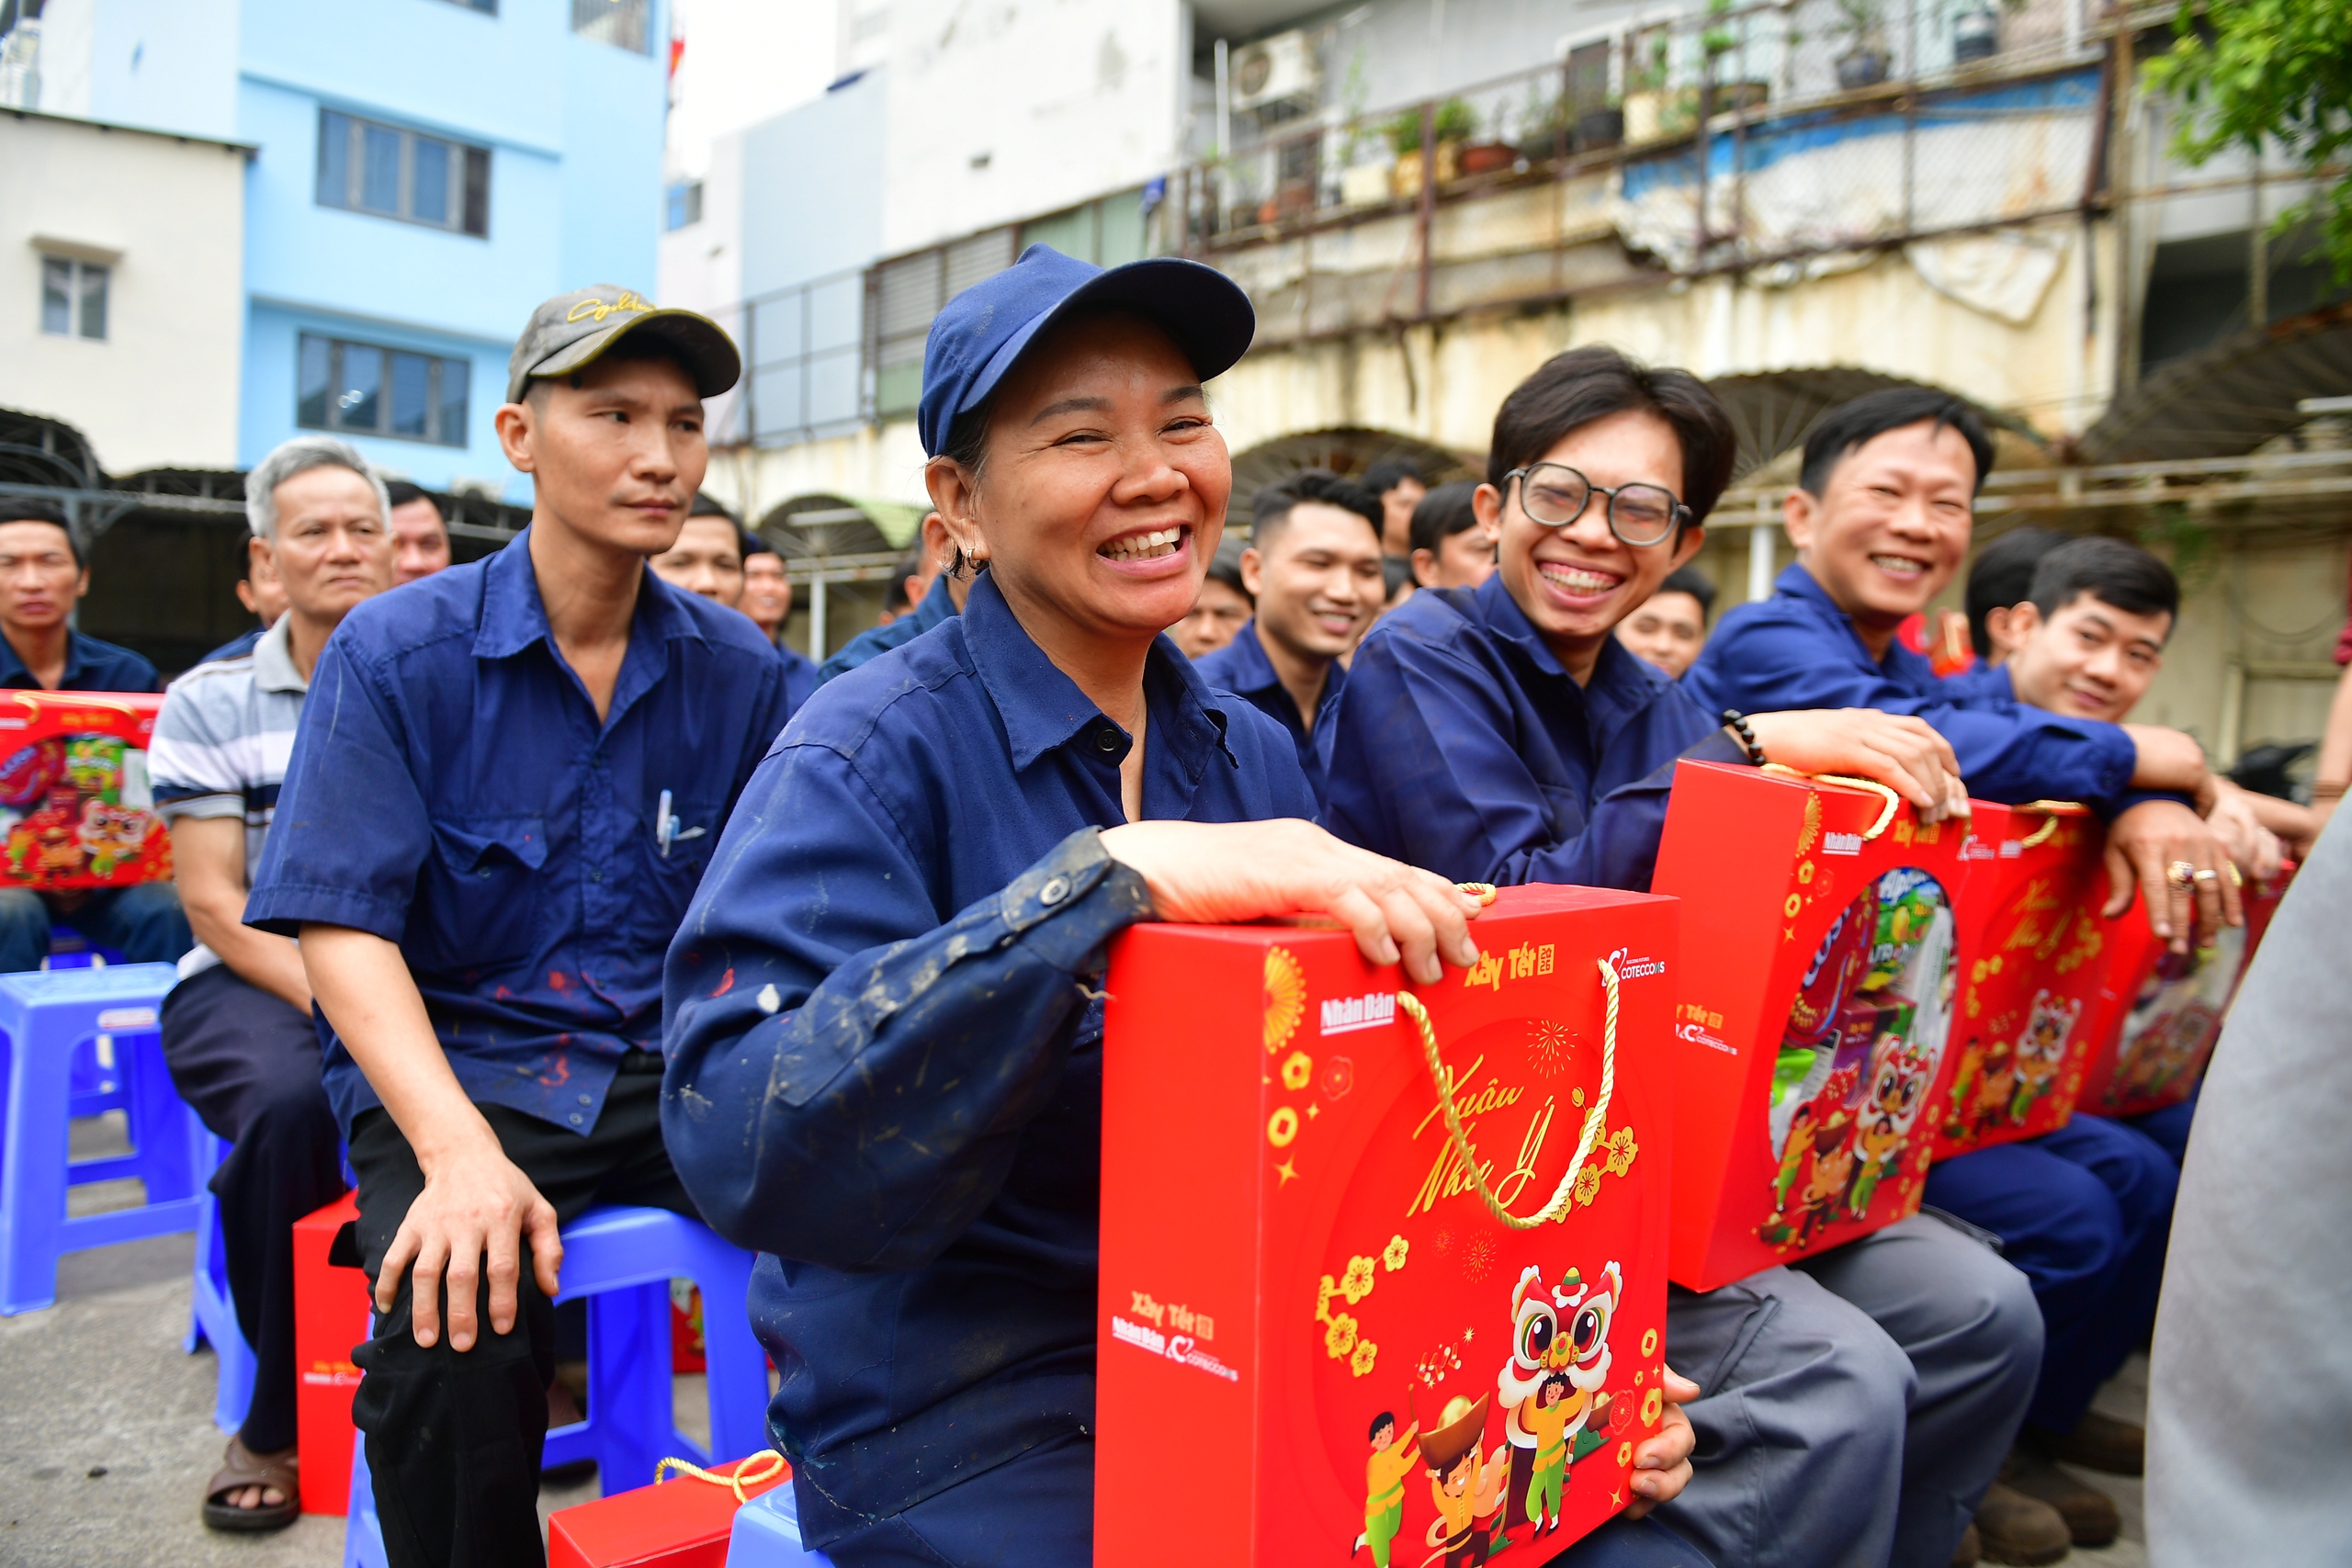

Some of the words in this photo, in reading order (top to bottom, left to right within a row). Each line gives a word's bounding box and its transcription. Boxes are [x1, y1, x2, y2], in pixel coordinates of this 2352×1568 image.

[1509, 941, 1536, 980] Tết
[1321, 997, 1363, 1028] Nhân
[1364, 992, 1395, 1021] Dân
